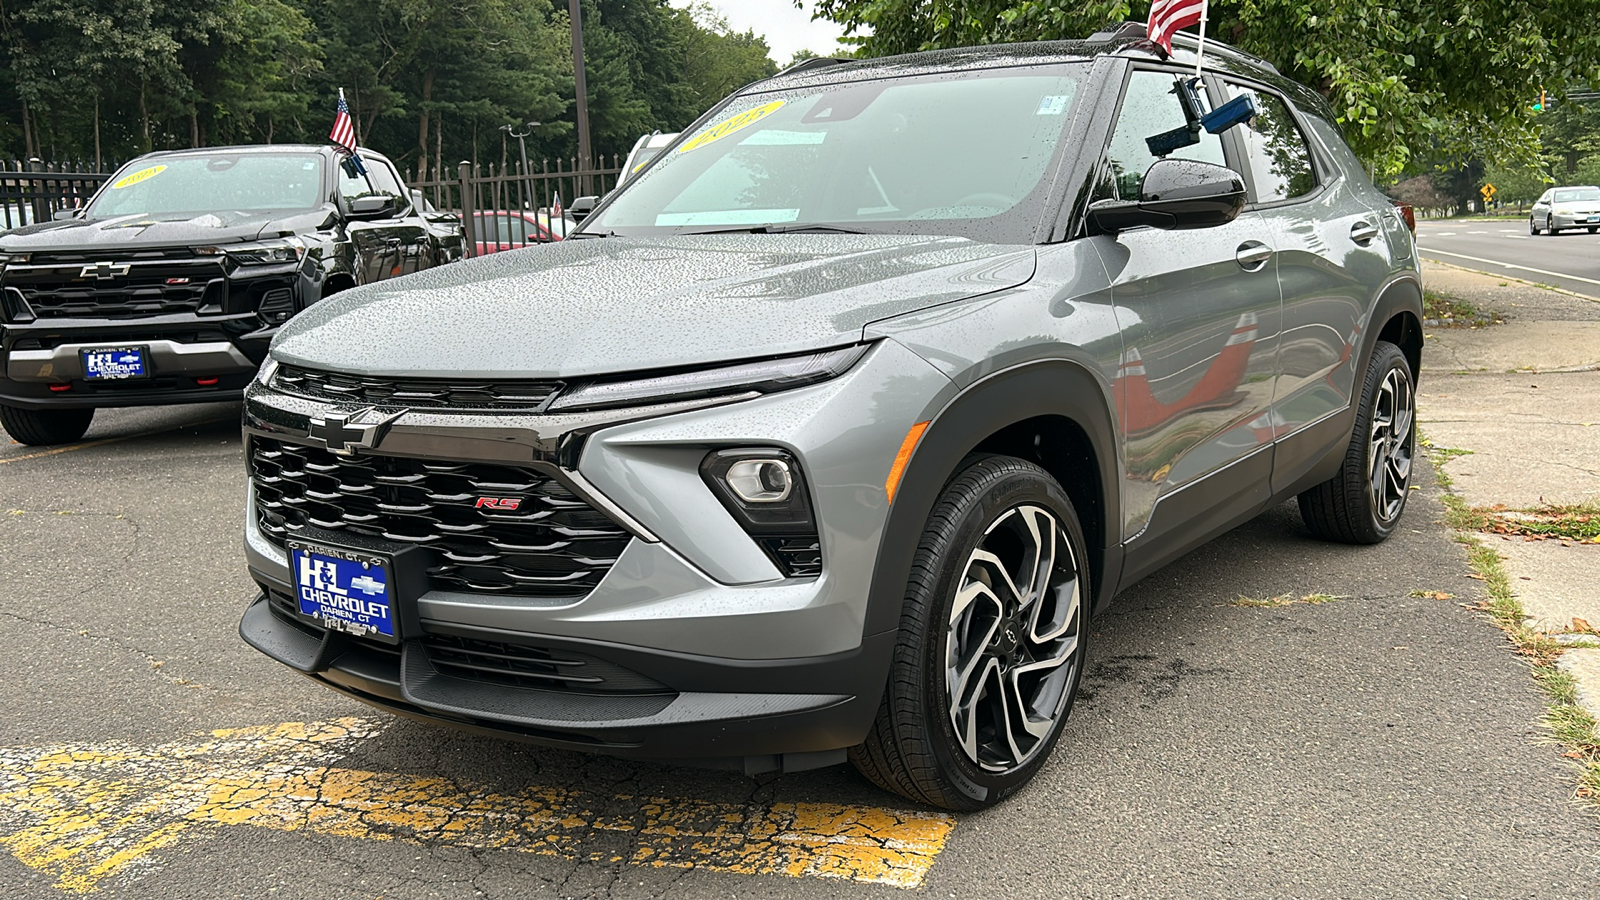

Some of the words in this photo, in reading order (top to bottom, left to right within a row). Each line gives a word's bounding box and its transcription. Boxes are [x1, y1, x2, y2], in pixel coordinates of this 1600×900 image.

[692, 104, 770, 148] 2025
[88, 364, 140, 372] CHEVROLET
[475, 497, 521, 510] RS
[307, 545, 344, 560] DARIEN,
[299, 556, 348, 596] H&L
[301, 586, 389, 619] CHEVROLET
[357, 614, 371, 623] CT
